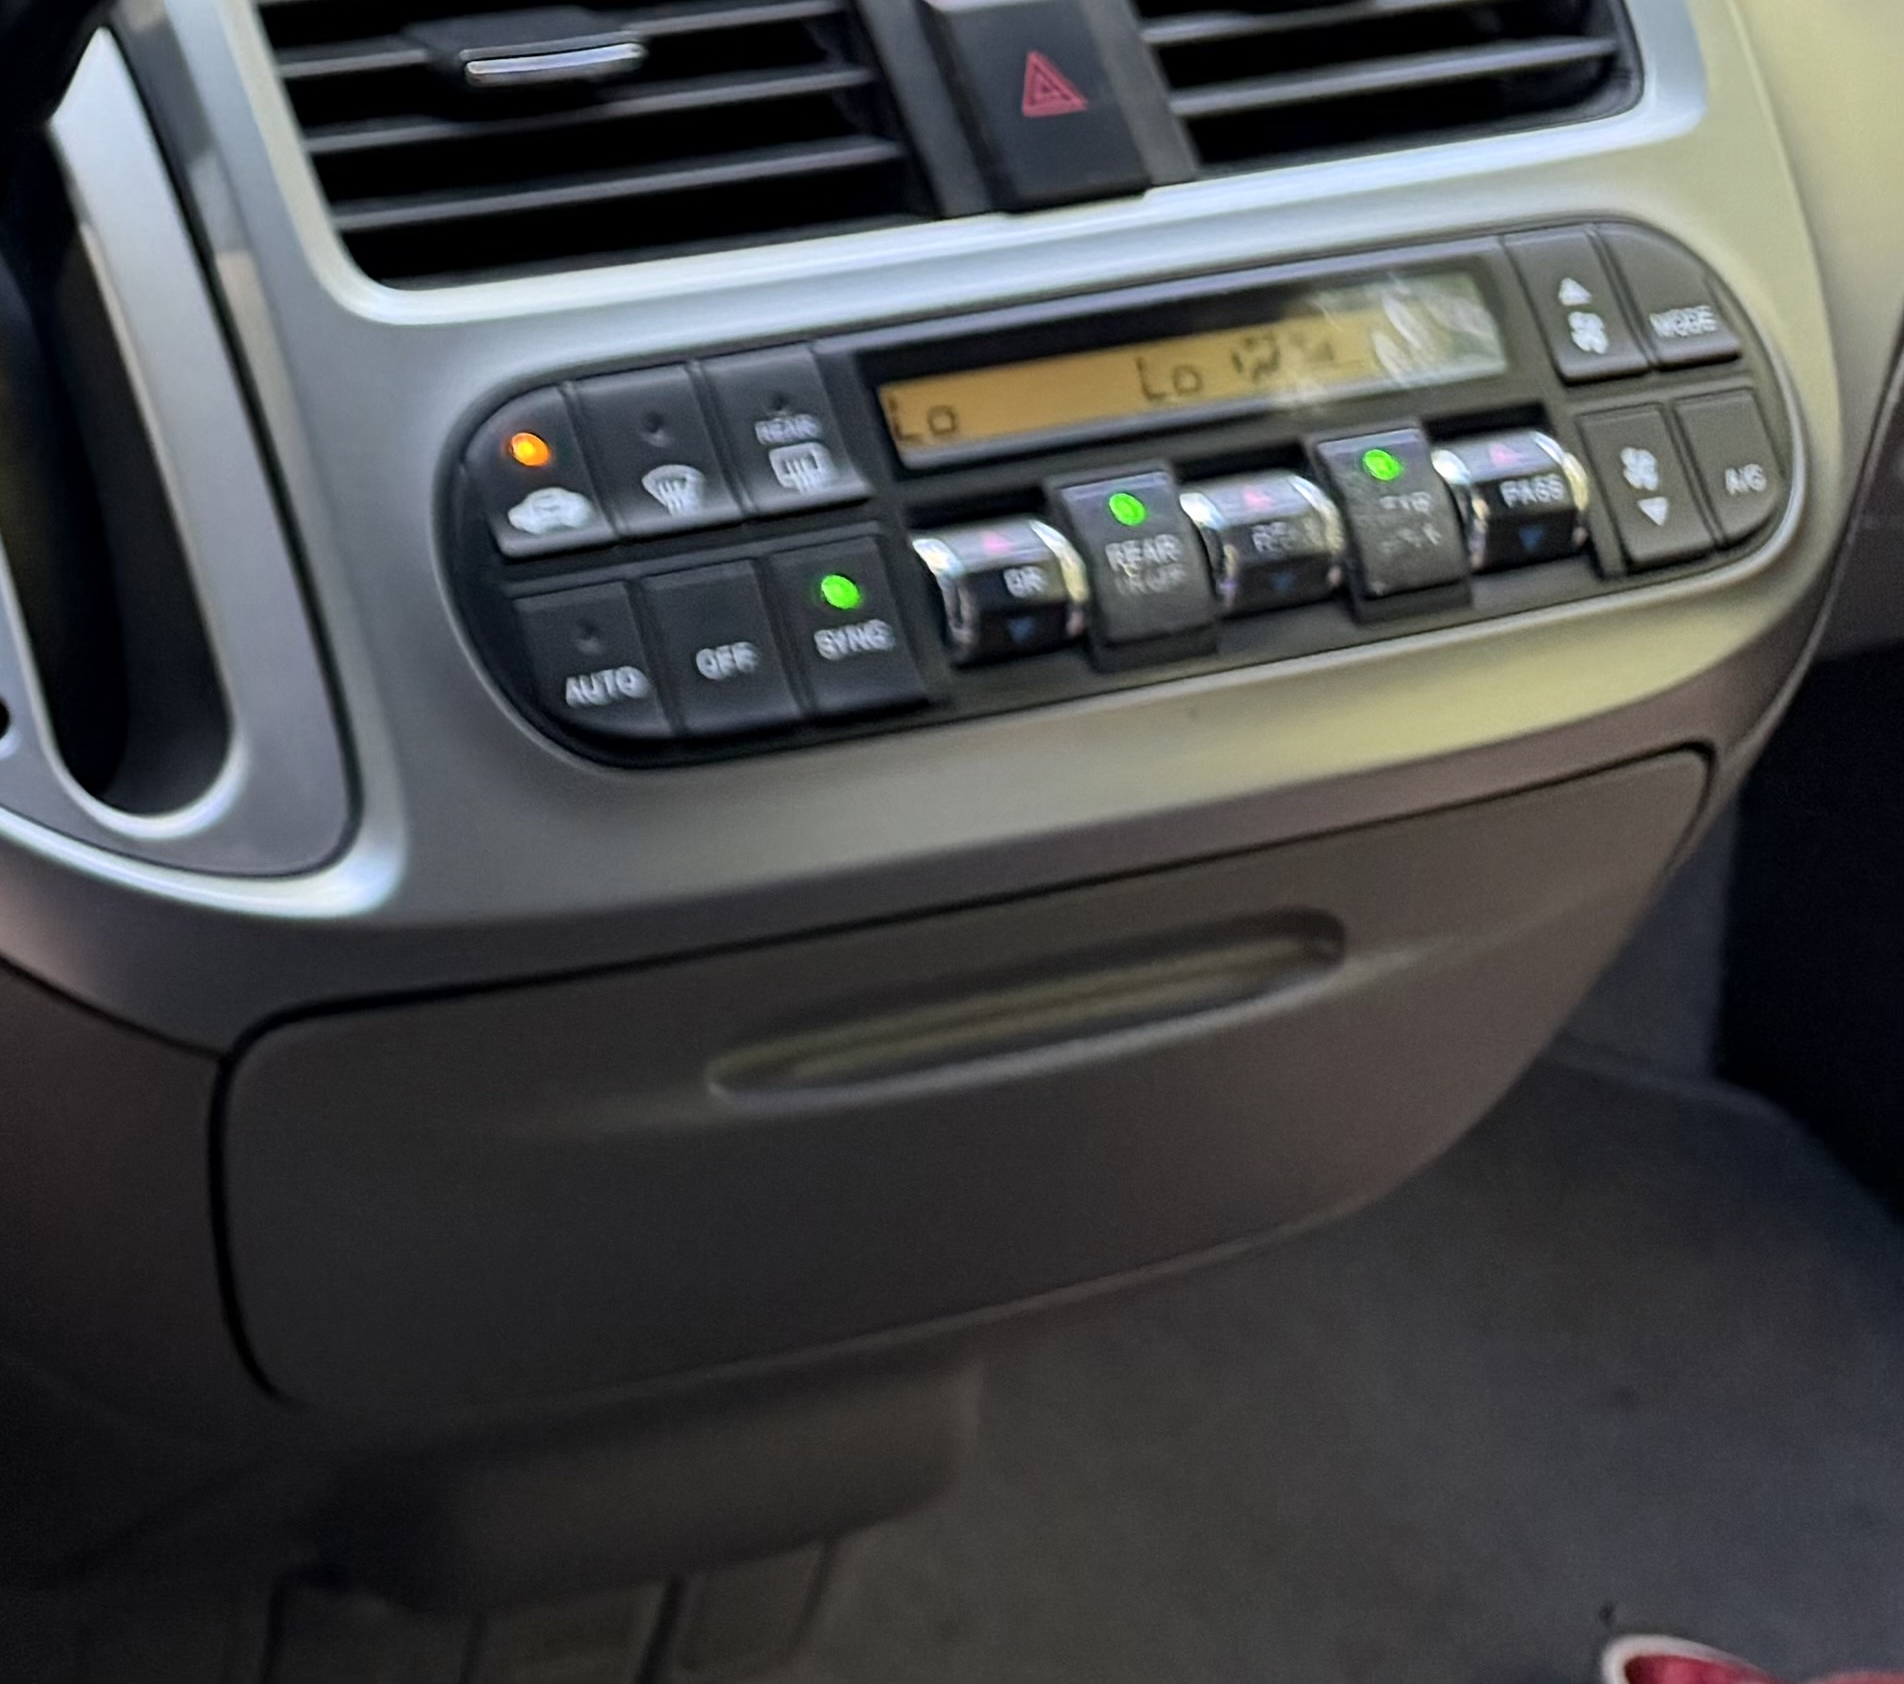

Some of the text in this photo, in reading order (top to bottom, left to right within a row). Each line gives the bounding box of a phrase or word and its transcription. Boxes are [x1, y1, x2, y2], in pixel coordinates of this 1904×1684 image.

[1650, 305, 1719, 337] MODE
[1500, 473, 1566, 509] PASS
[1105, 533, 1182, 572] REAR
[695, 641, 760, 681] OFF
[565, 665, 653, 708] AUTO
